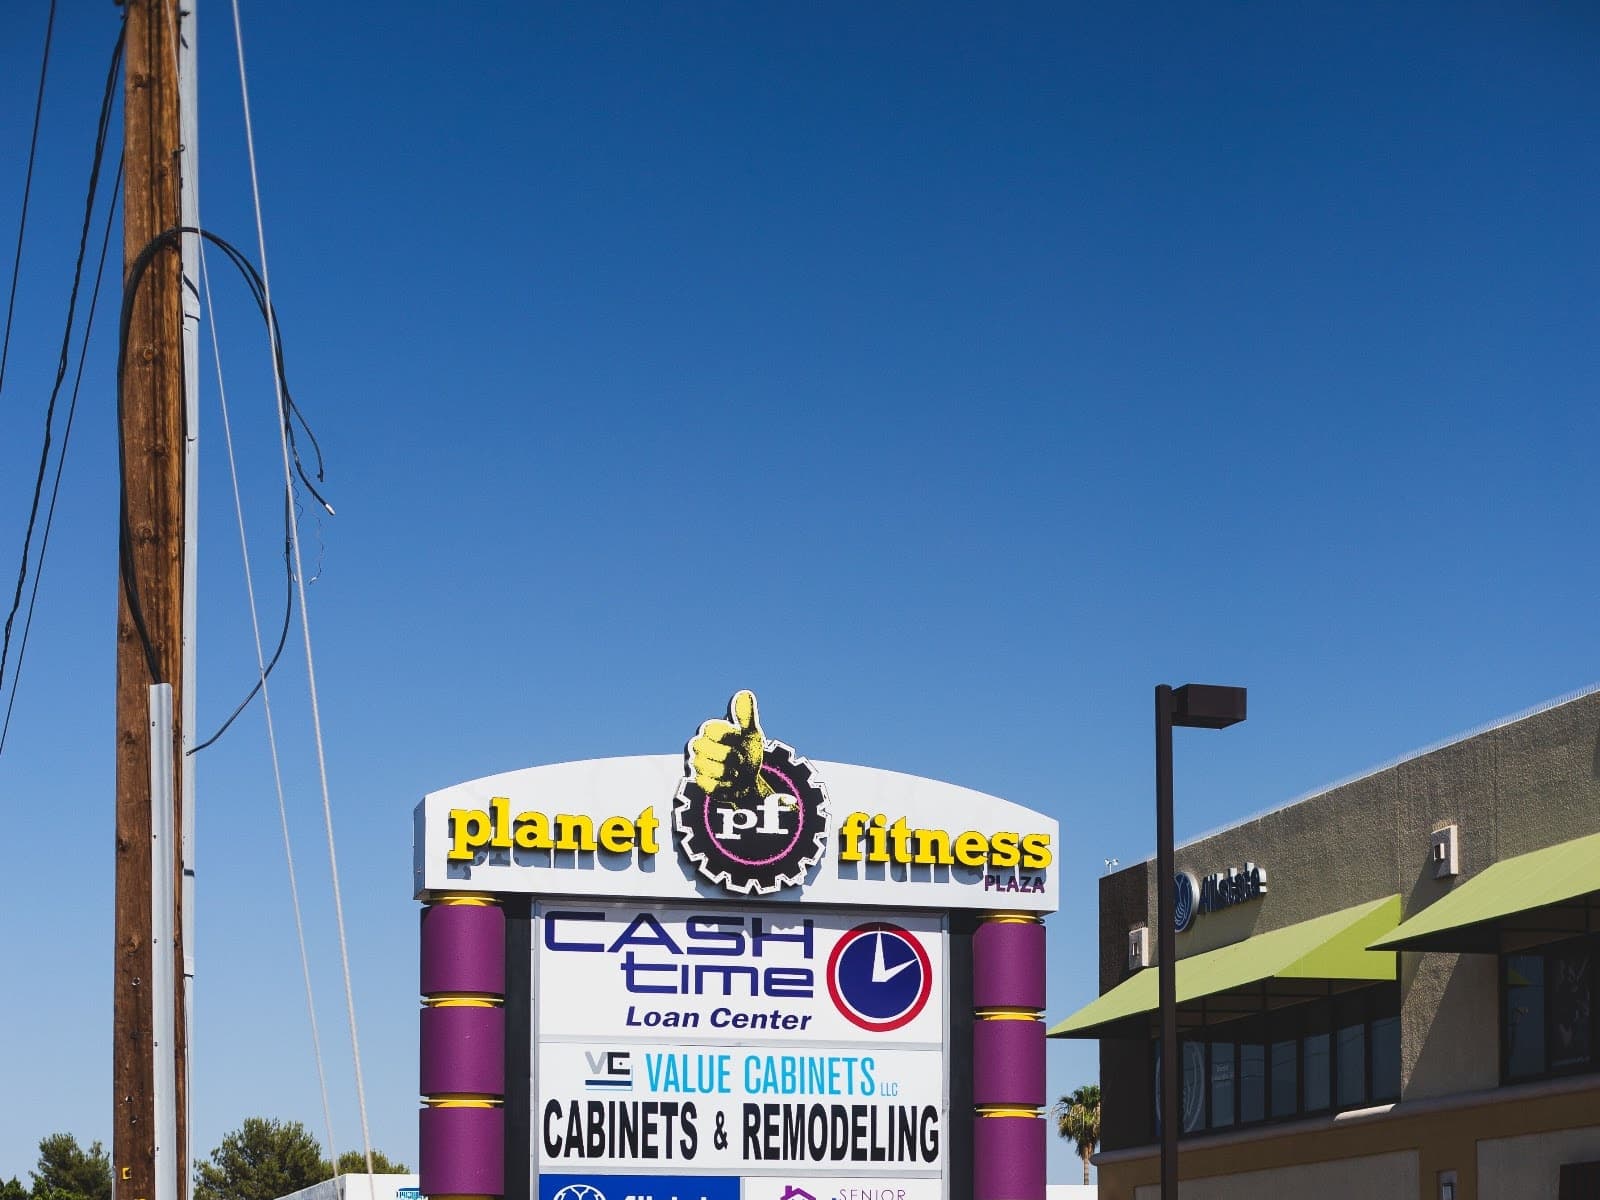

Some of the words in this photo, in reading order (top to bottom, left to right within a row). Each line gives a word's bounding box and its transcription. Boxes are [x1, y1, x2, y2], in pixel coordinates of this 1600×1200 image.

[447, 797, 660, 859] planet
[840, 812, 1053, 868] fitness
[715, 793, 799, 839] pf
[984, 874, 1045, 893] PLAZA
[544, 910, 814, 959] CASH
[620, 951, 814, 999] time
[625, 1005, 700, 1029] Loan
[709, 1006, 812, 1031] Center
[645, 1053, 731, 1094] VALUE
[743, 1055, 876, 1097] CABINETS
[880, 1082, 898, 1097] LLC
[543, 1099, 698, 1160] CABINETS
[713, 1110, 728, 1150] &
[742, 1102, 939, 1163] REMODELING
